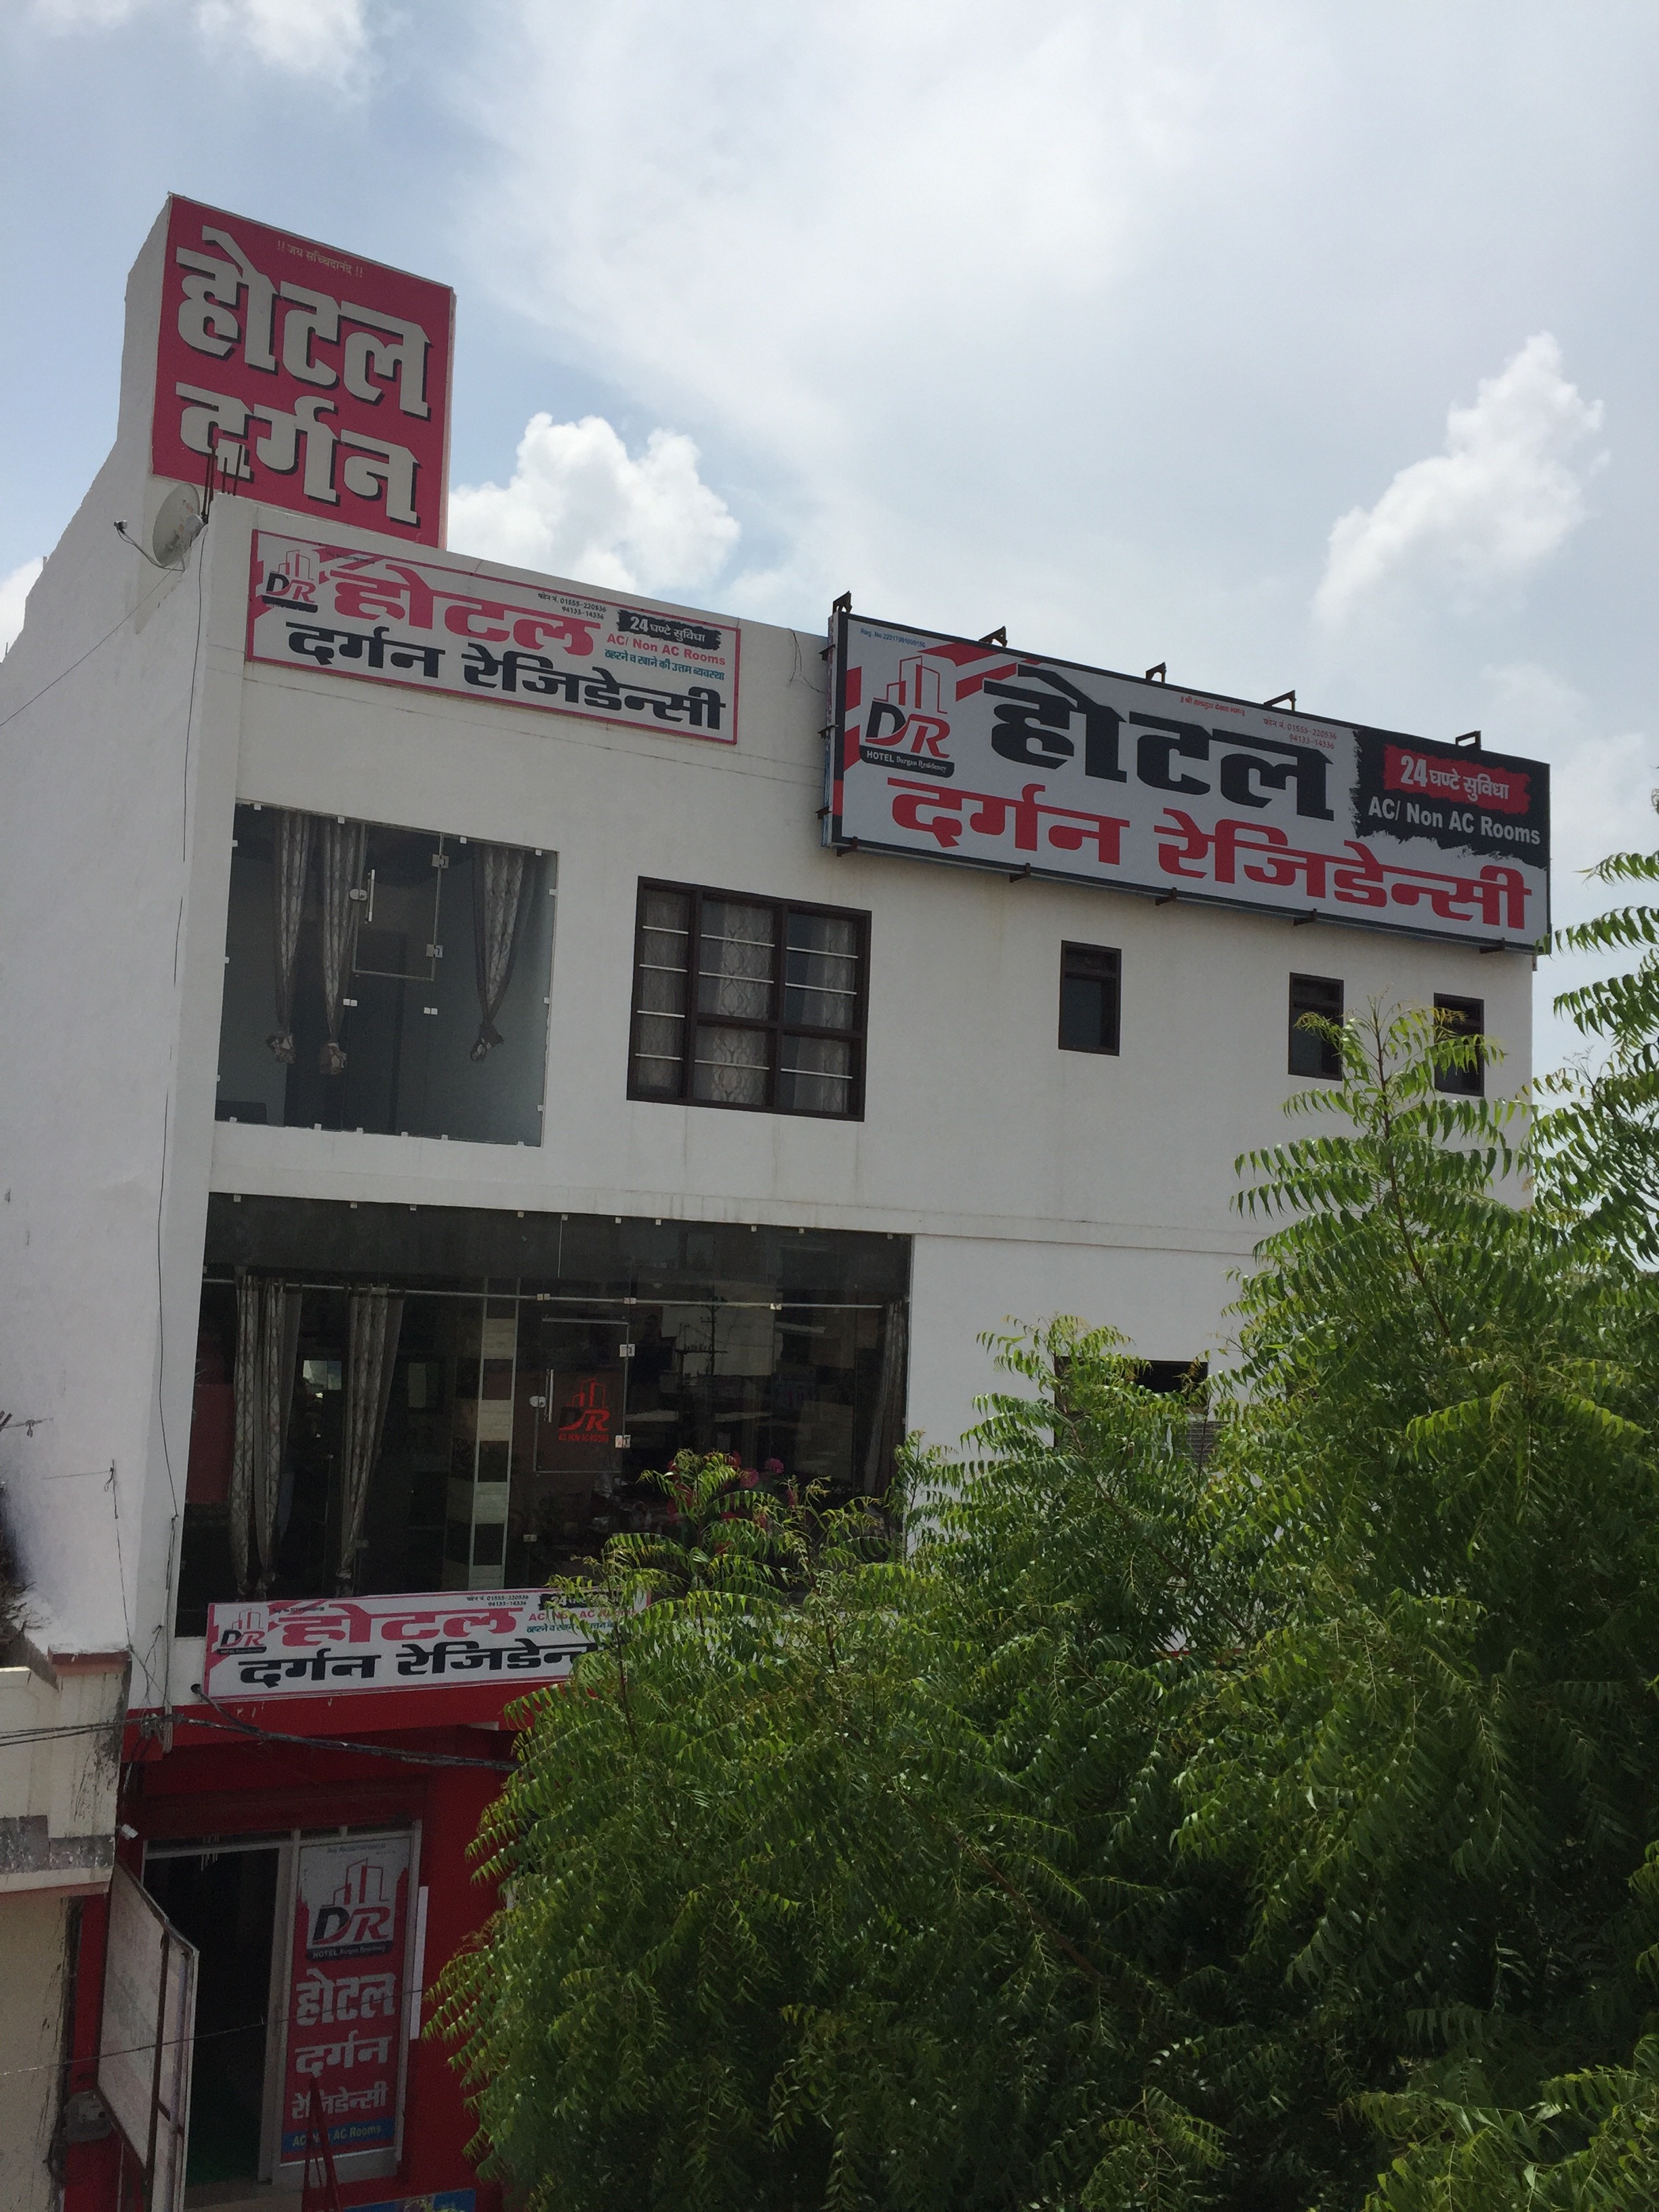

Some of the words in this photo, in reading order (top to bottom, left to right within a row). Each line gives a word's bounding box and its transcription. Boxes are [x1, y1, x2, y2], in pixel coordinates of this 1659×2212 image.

[287, 244, 304, 257] जय
[176, 224, 434, 422] होटल
[266, 572, 316, 603] DR
[329, 564, 601, 656] होटल
[630, 616, 649, 632] 24
[650, 624, 672, 636] घण्टे
[673, 628, 705, 643] सुविधा
[605, 649, 628, 662] ठहरने
[638, 655, 657, 668] खाने
[659, 658, 670, 670] की
[672, 662, 692, 675] उत्तम
[693, 667, 725, 681] व्यवस्था
[607, 633, 629, 645] AC/
[633, 638, 657, 652] Non
[661, 645, 680, 656] AC
[684, 649, 726, 666] Rooms
[286, 622, 446, 679] दर्गन
[462, 642, 726, 731] रेजिडेन्सी
[865, 701, 951, 758] DR
[983, 664, 1334, 821] होटल
[867, 750, 895, 763] HOTEL
[896, 756, 918, 767] Dargan
[918, 760, 947, 773] Residency
[1400, 755, 1427, 788] 24
[1429, 767, 1460, 791] घण्टे
[1462, 773, 1509, 801] सुविधा
[1368, 796, 1400, 820] AC/
[1407, 803, 1443, 828] Non
[1448, 810, 1475, 834] AC
[1480, 816, 1541, 845] Rooms
[887, 777, 1130, 865] दर्गन
[1153, 808, 1532, 929] रेजिडेन्सी
[220, 1630, 265, 1647] DR
[279, 1604, 523, 1647] होटल
[239, 1647, 381, 1688] दर्गन
[312, 1906, 391, 1946] DR
[312, 1950, 337, 1959] HOTEL
[295, 1968, 396, 2026] होटल
[294, 2030, 392, 2078] दर्गन
[333, 2128, 347, 2142] AC
[350, 2125, 382, 2138] Rooms
